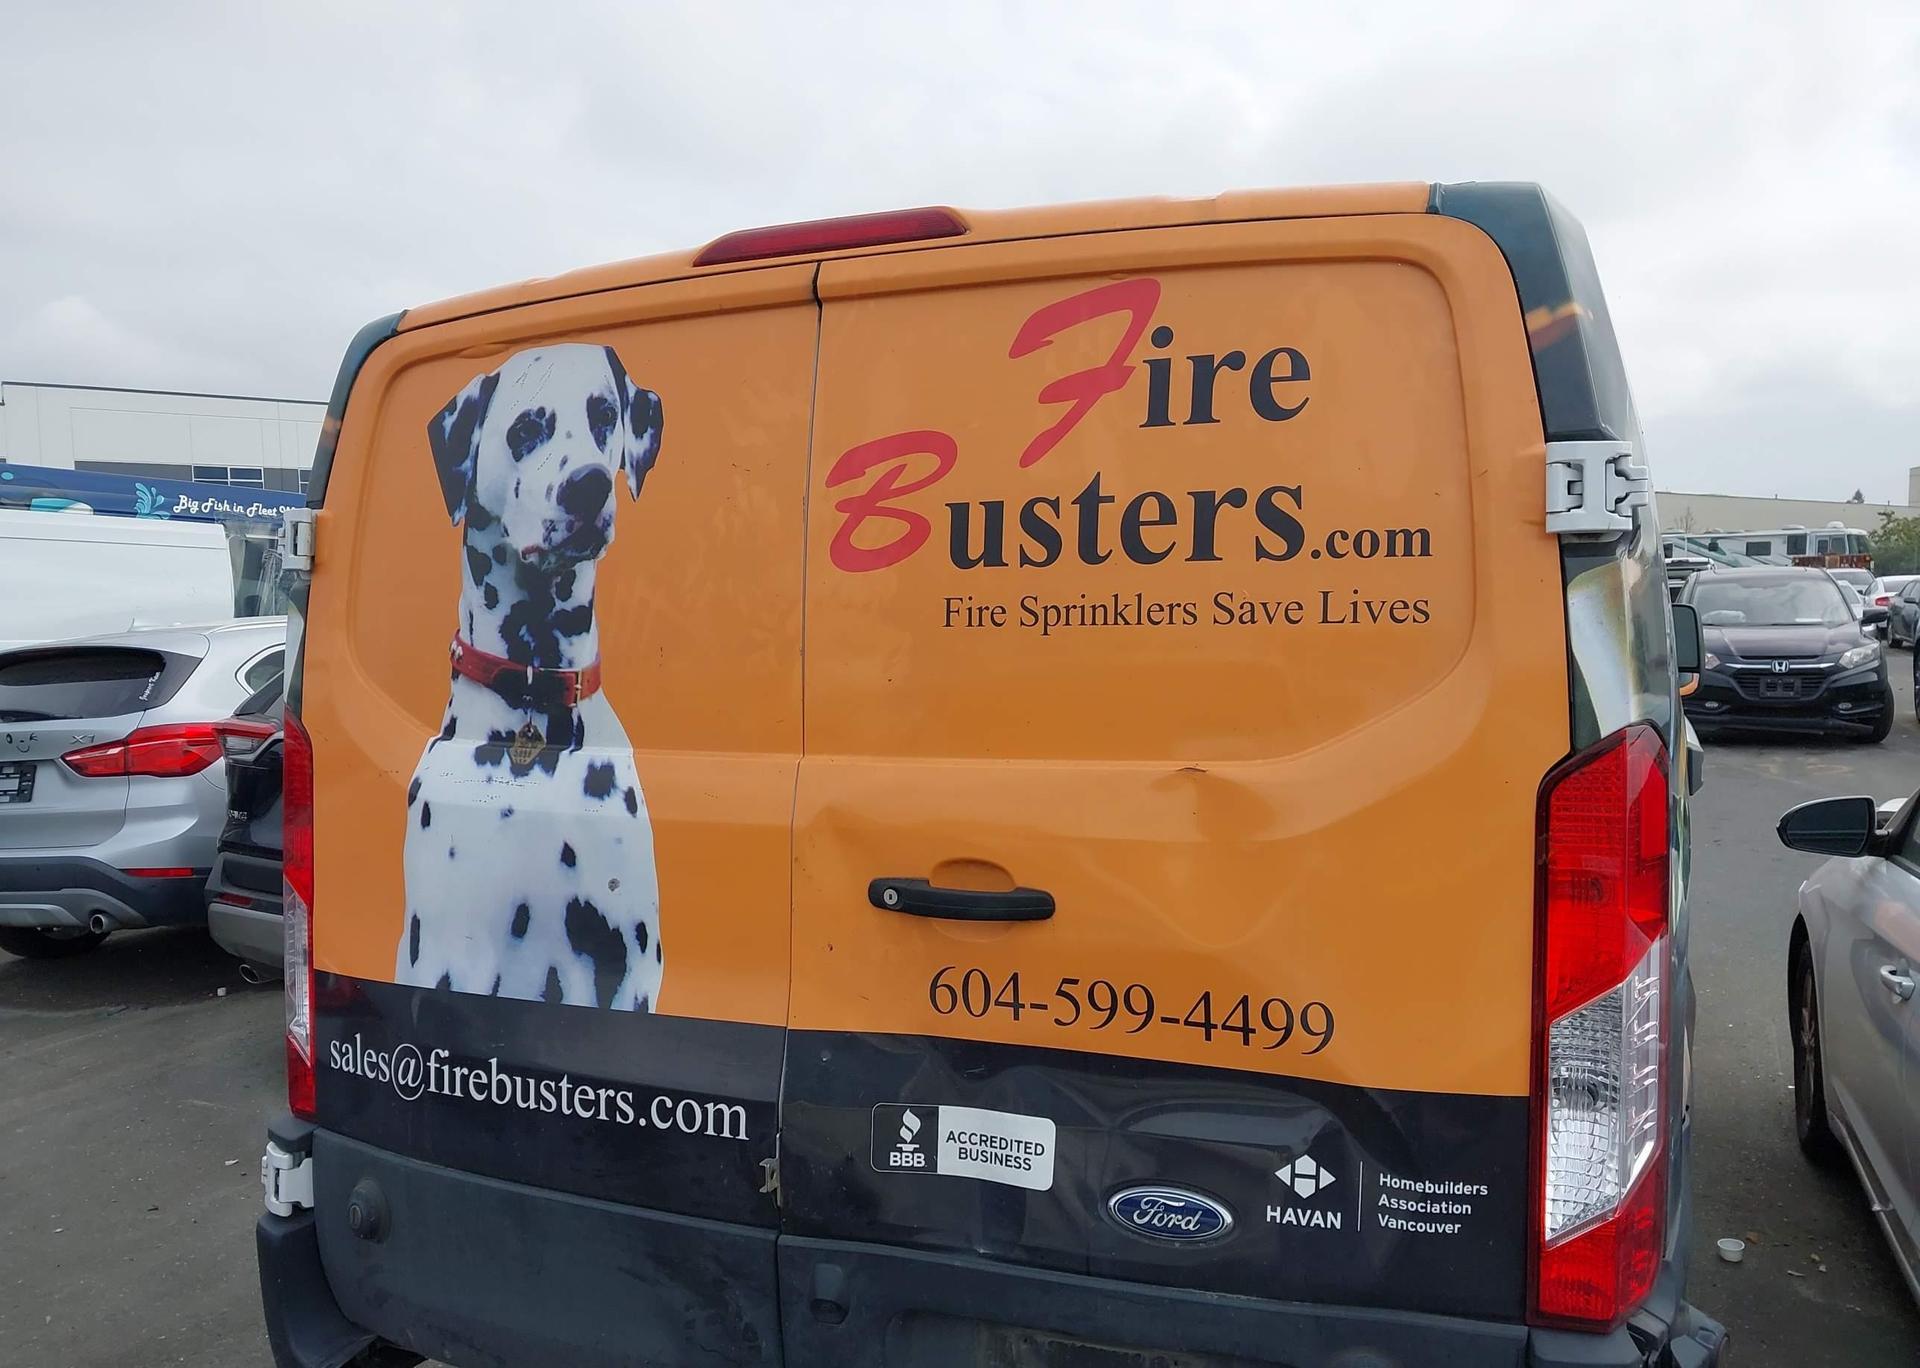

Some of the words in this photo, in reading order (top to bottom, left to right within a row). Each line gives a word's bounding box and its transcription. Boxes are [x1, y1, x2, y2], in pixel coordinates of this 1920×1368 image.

[1008, 277, 1311, 468] Fire
[173, 494, 199, 514] Big
[201, 498, 231, 513] Fish
[233, 503, 244, 513] in
[246, 503, 277, 518] Fleet
[825, 430, 1433, 573] Busters.com
[943, 597, 1007, 628] Fire
[1019, 593, 1198, 636] Sprinklers
[1212, 591, 1304, 627] Save
[1317, 588, 1431, 626] Lives
[70, 734, 96, 745] X1
[928, 966, 1335, 1055] 604-599-4499
[329, 1033, 750, 1141] sales@firebusters.com
[945, 1129, 1045, 1157] ACCREDITED
[889, 1151, 926, 1168] BBB
[957, 1147, 1032, 1172] BUSINESS
[1378, 1172, 1489, 1196] Homebuilders
[1132, 1196, 1202, 1232] Ford
[1377, 1193, 1473, 1216] Association
[1266, 1205, 1342, 1230] HAVAN
[1377, 1213, 1462, 1235] Vancouver
